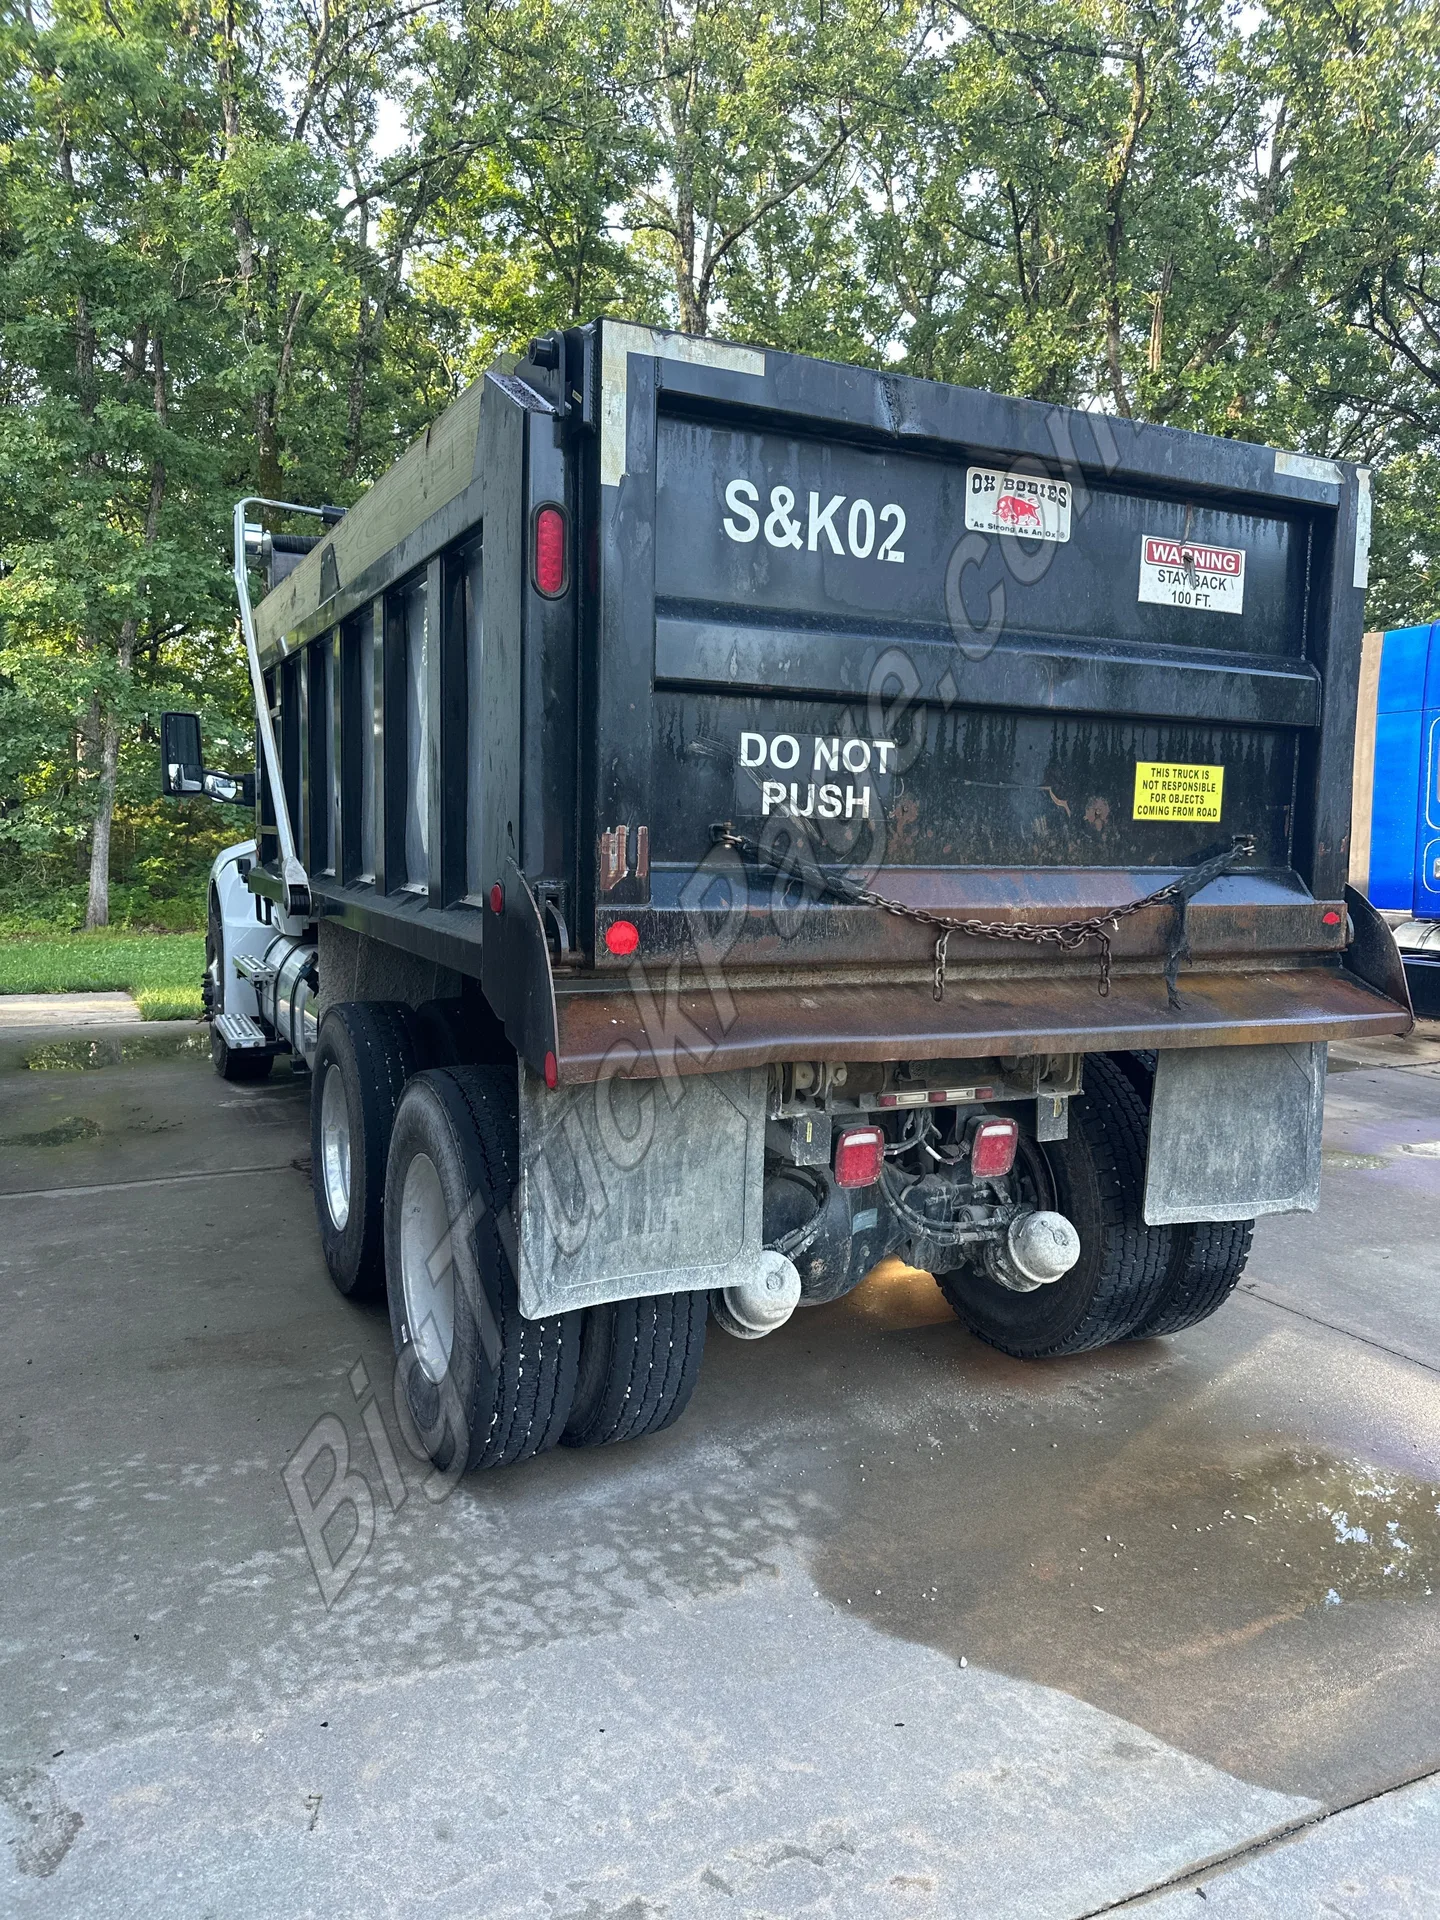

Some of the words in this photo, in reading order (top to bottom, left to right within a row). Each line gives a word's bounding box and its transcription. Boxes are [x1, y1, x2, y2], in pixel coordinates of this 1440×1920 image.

[972, 473, 996, 494] OX
[1003, 478, 1067, 508] BODIES
[723, 478, 906, 563] S&K02
[987, 522, 1015, 533] Strong
[1158, 569, 1189, 586] STAY
[1194, 575, 1227, 591] BACK
[1172, 590, 1191, 605] 100
[1195, 593, 1211, 608] FT.
[740, 732, 800, 769] DO
[813, 736, 895, 774] NOT
[1151, 768, 1170, 778] THIS
[1173, 769, 1199, 779] TRUCK
[1202, 770, 1209, 780] IS
[1142, 780, 1159, 790] NOT
[1162, 781, 1216, 792] RESPONSIBLE
[761, 781, 871, 819] PUSH
[1150, 793, 1166, 803] FOR
[1169, 794, 1204, 804] OBJECTS
[1137, 805, 1170, 816] COMING
[1172, 807, 1194, 817] FROM
[1196, 808, 1218, 817] ROAD
